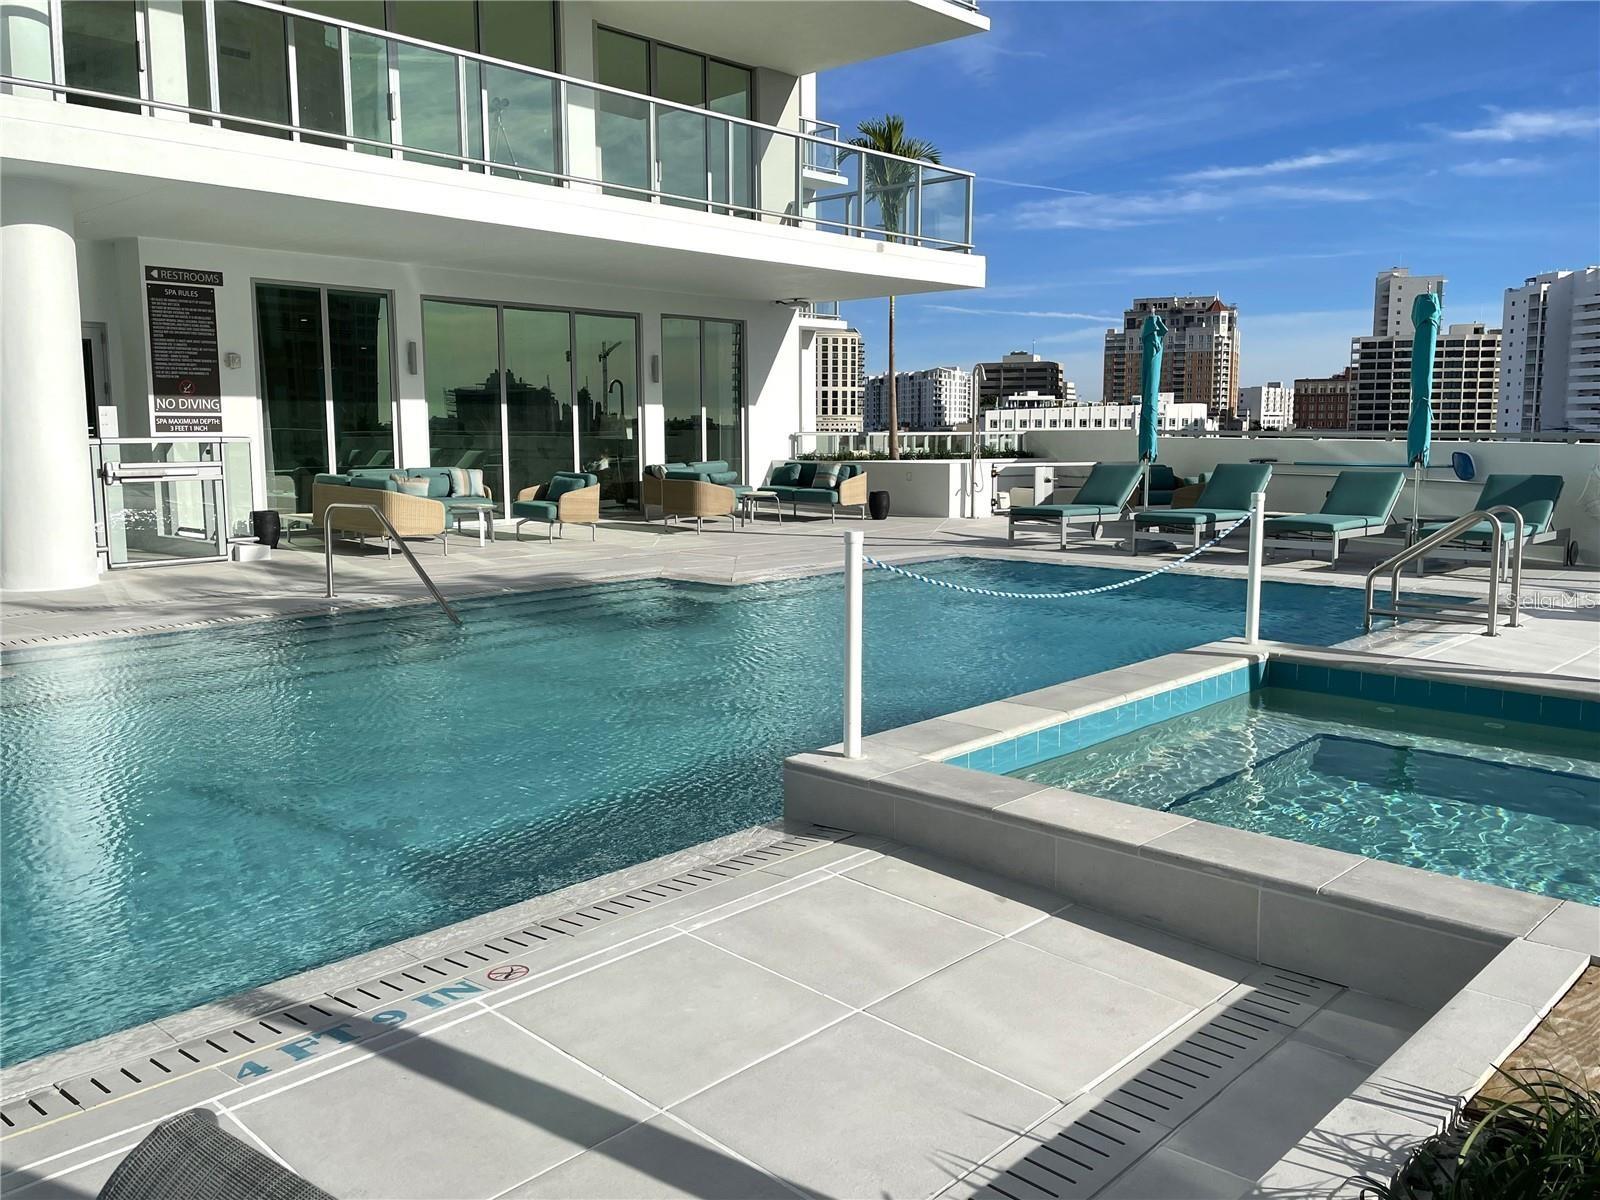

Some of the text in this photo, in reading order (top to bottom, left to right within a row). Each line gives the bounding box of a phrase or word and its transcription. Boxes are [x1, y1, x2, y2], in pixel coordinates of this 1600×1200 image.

[161, 270, 219, 283] RESTROOMS
[165, 288, 198, 298] SPA RULES
[156, 398, 220, 410] NO DIVING
[236, 980, 484, 1080] 4 FT 9 IN
